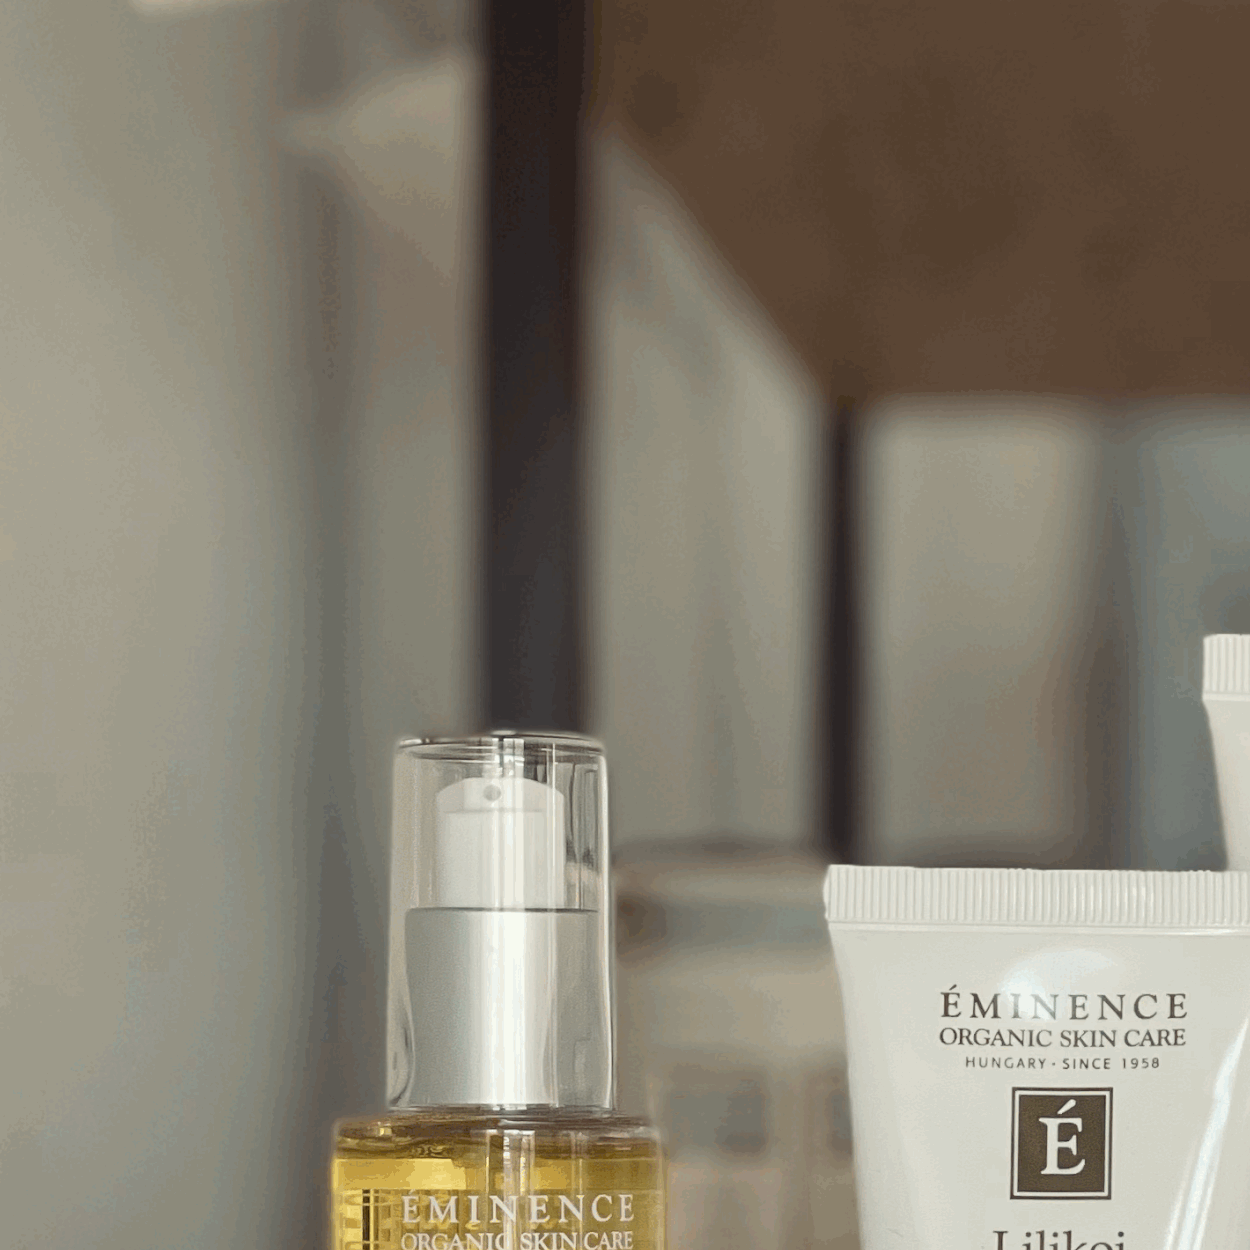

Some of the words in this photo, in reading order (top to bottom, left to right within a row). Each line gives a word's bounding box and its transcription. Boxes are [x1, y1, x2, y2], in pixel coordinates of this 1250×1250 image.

[940, 984, 1188, 1021] ÉMINENCE
[939, 1027, 1052, 1047] ORGANIC
[1059, 1028, 1117, 1048] SKIN
[1123, 1028, 1186, 1047] CARE
[965, 1057, 1047, 1070] HUNGARY
[1062, 1057, 1111, 1071] SINCE
[1121, 1057, 1160, 1070] 1958
[1038, 1098, 1086, 1177] É
[401, 1189, 634, 1224] ÉMINENCE
[583, 1230, 634, 1250] CARE
